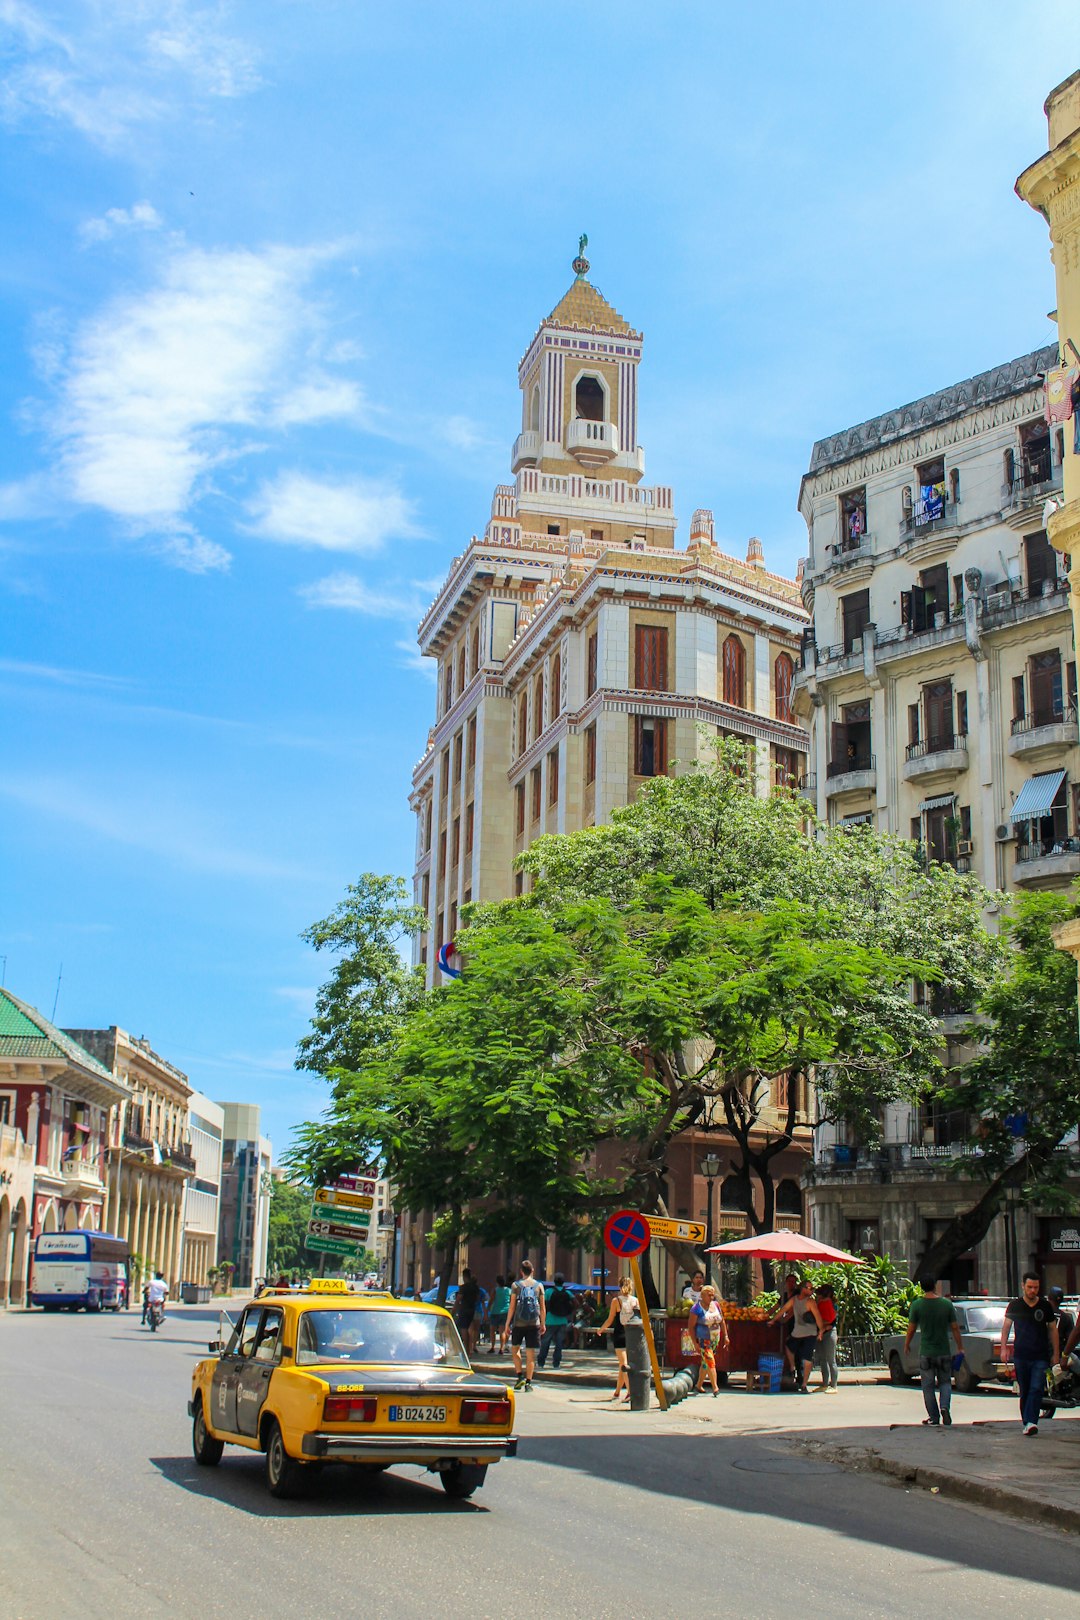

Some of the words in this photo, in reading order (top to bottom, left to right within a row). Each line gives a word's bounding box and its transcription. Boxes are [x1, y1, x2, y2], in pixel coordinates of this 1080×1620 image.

[397, 1408, 402, 1420] B
[405, 1408, 424, 1420] 024
[426, 1408, 445, 1420] 245
